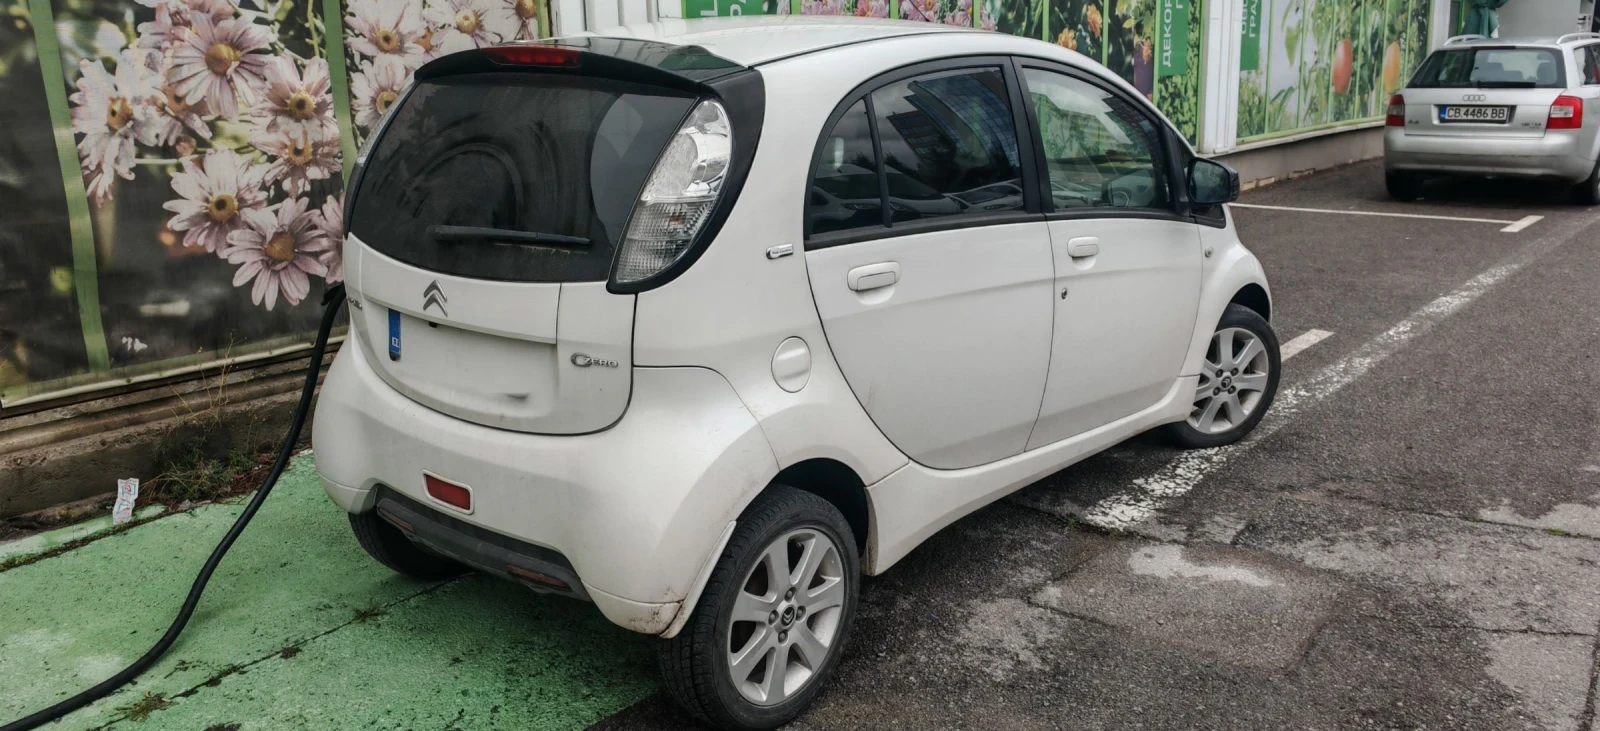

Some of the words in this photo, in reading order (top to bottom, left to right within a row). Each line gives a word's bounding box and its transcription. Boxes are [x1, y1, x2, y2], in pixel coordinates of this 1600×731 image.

[1249, 0, 1258, 37] ГРА
[1464, 108, 1489, 118] 4486
[1491, 108, 1505, 119] BB
